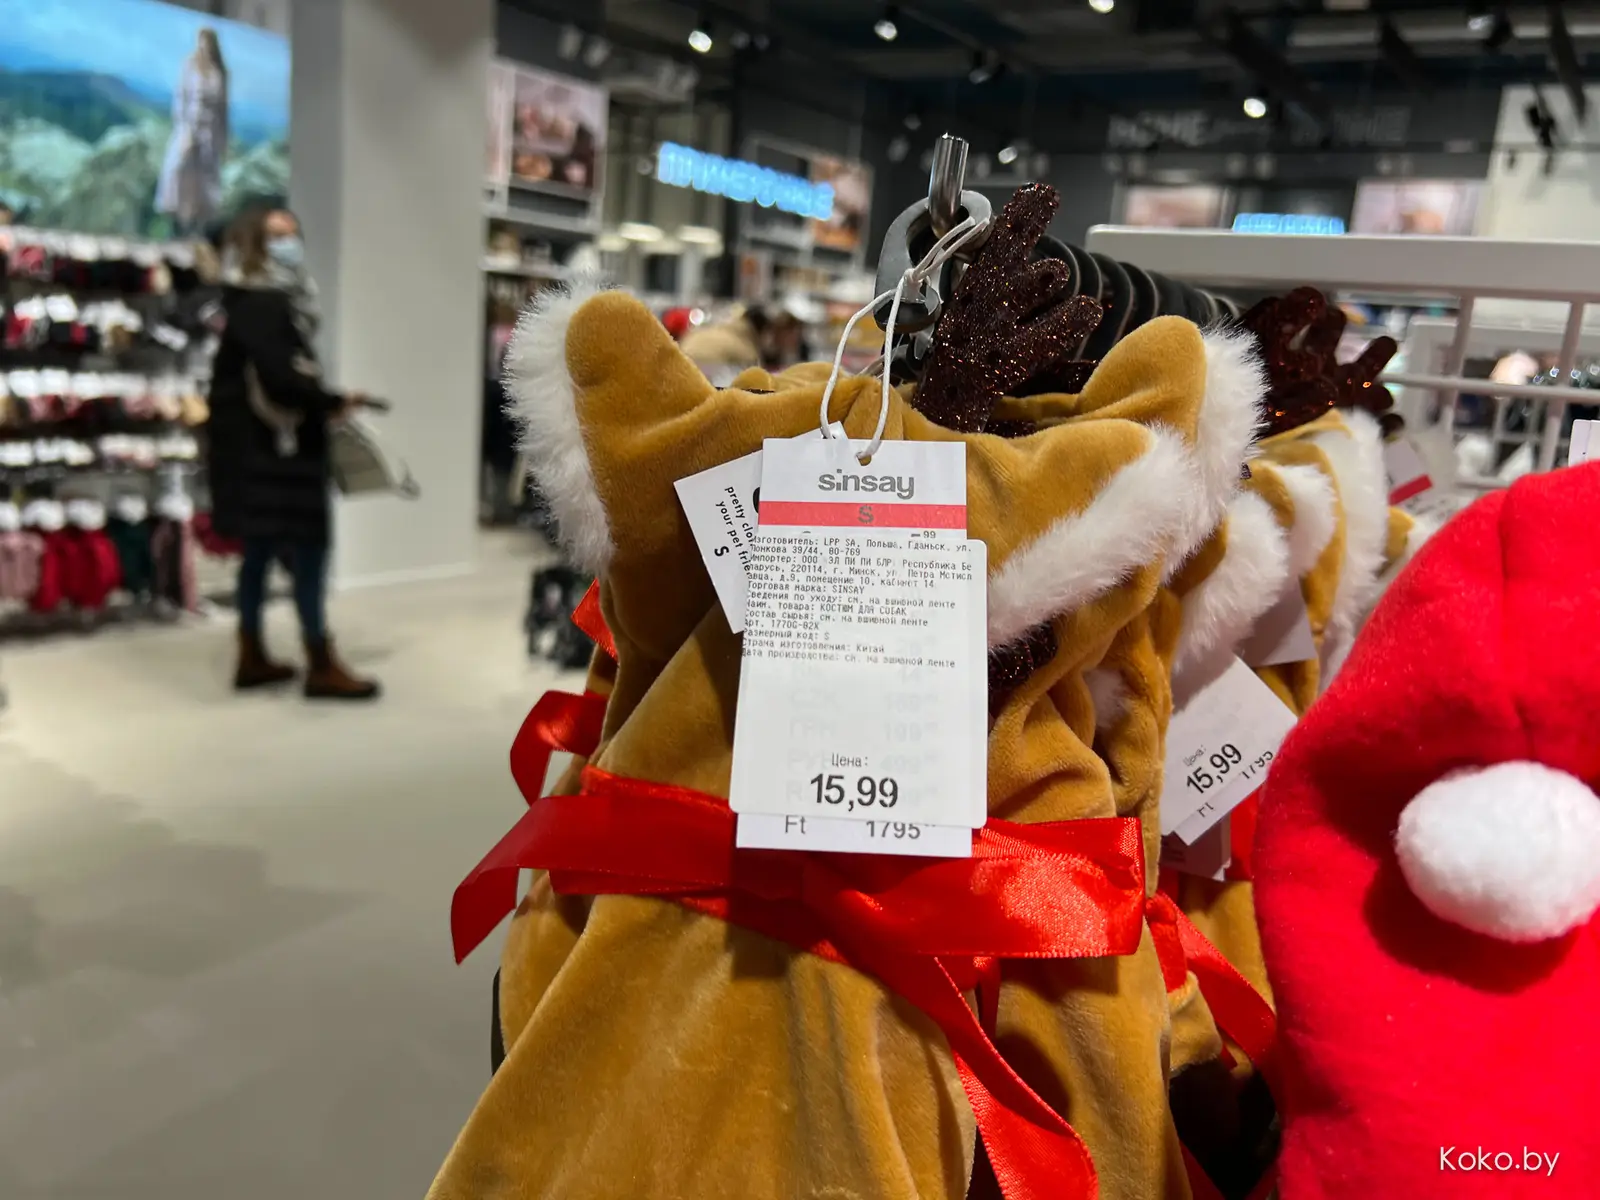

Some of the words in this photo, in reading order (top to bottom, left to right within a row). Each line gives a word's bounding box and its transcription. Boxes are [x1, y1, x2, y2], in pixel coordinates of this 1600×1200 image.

[818, 468, 915, 500] sinsay
[724, 486, 745, 519] pretty
[858, 505, 874, 523] S
[715, 501, 733, 526] your
[727, 530, 743, 548] pet
[824, 538, 840, 546] LPP
[714, 546, 730, 557] S
[829, 547, 861, 556] 80-769
[845, 557, 856, 565] ПИ
[860, 557, 871, 566] ПИ
[902, 560, 956, 571] Республика
[962, 562, 972, 571] Бе
[908, 569, 935, 579] Петра
[806, 575, 854, 585] помещение
[925, 579, 934, 588] 14
[795, 584, 826, 593] марка:
[832, 586, 865, 595] SINSAY
[778, 601, 814, 611] товара:
[794, 592, 805, 601] по
[929, 601, 956, 609] ленте
[901, 618, 928, 627] ленте
[856, 644, 885, 653] Китай
[831, 752, 869, 768] Цена:
[1186, 743, 1242, 794] 15,99
[810, 773, 899, 812] 15,99
[785, 814, 806, 835] Ft
[866, 820, 921, 839] 1795
